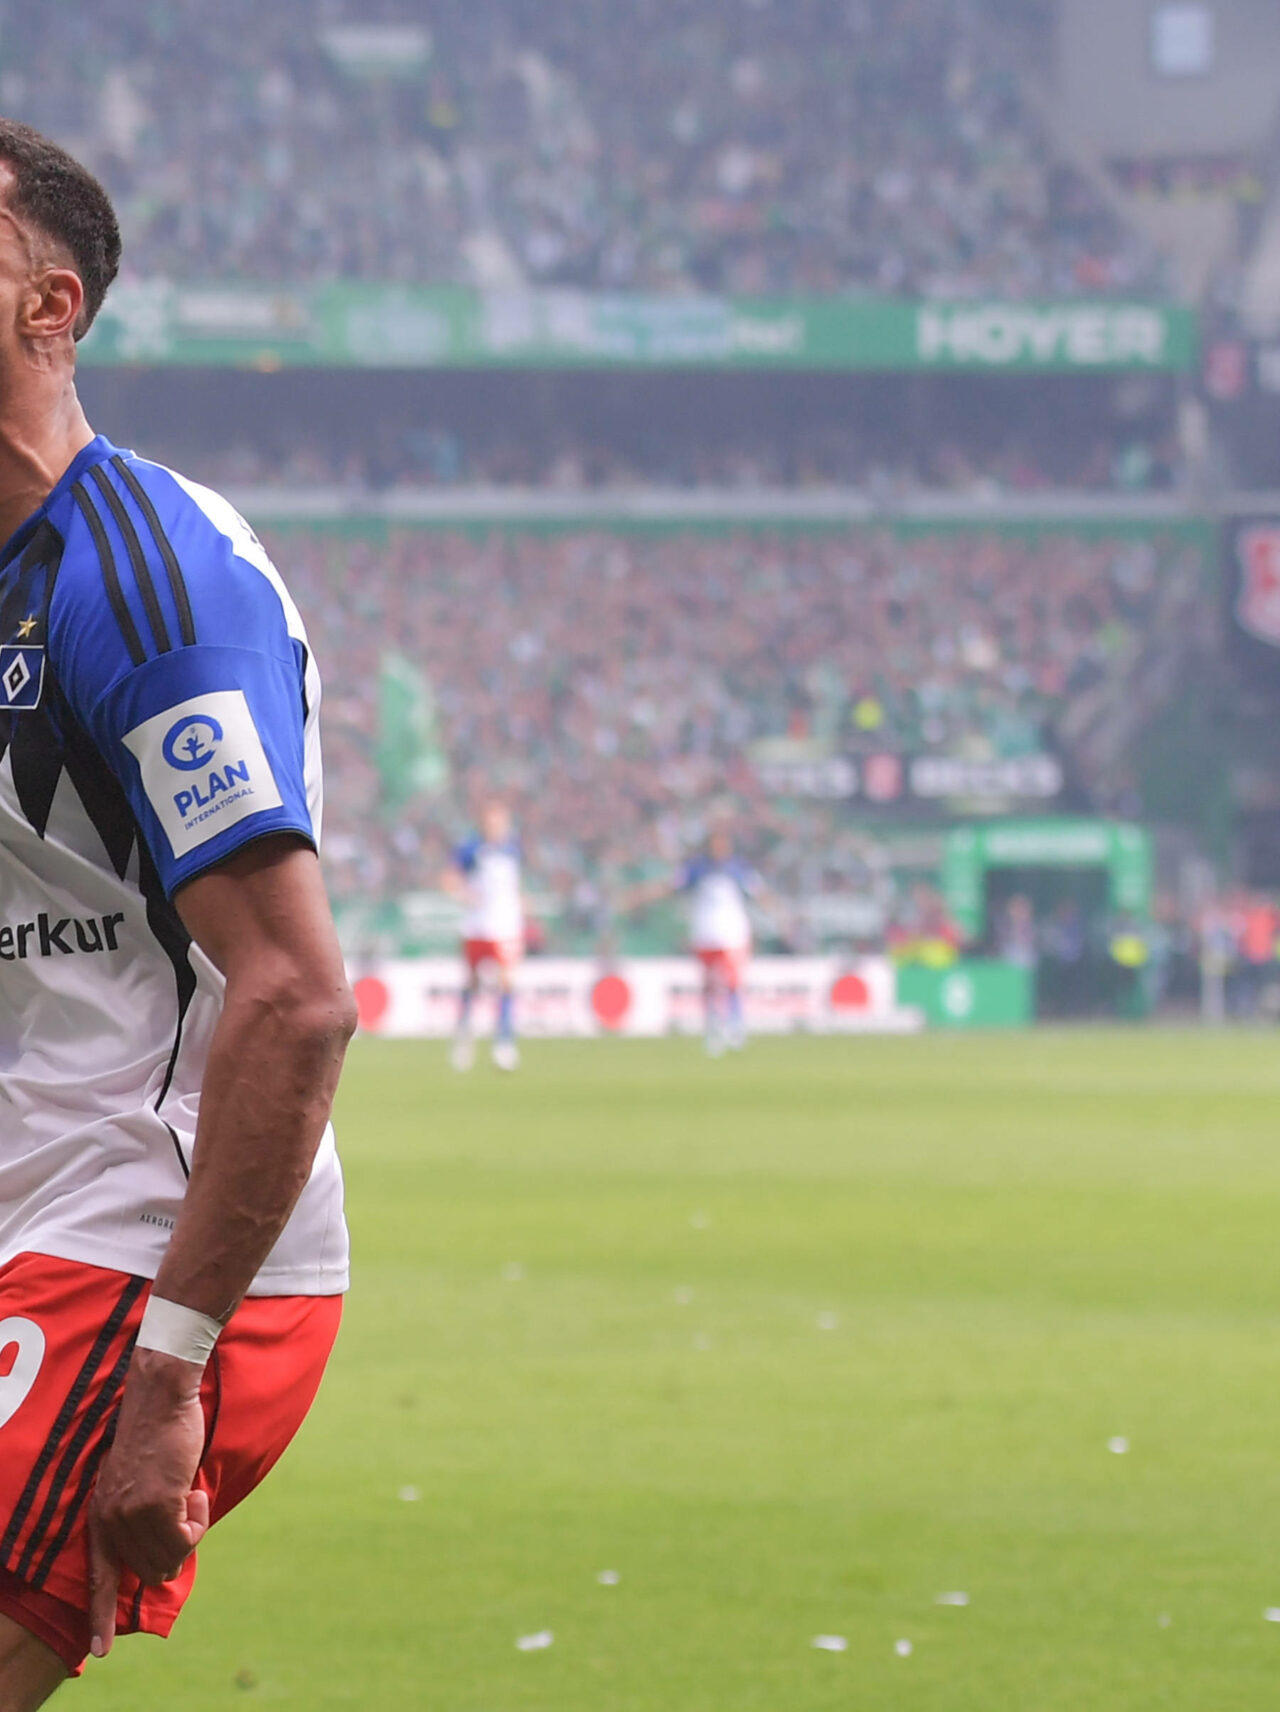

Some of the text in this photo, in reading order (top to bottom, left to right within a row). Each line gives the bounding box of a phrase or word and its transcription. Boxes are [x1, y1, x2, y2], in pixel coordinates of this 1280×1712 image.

[918, 306, 1165, 363] HOYER
[173, 760, 250, 818] PLAN
[185, 787, 255, 830] INTERNATIONAL
